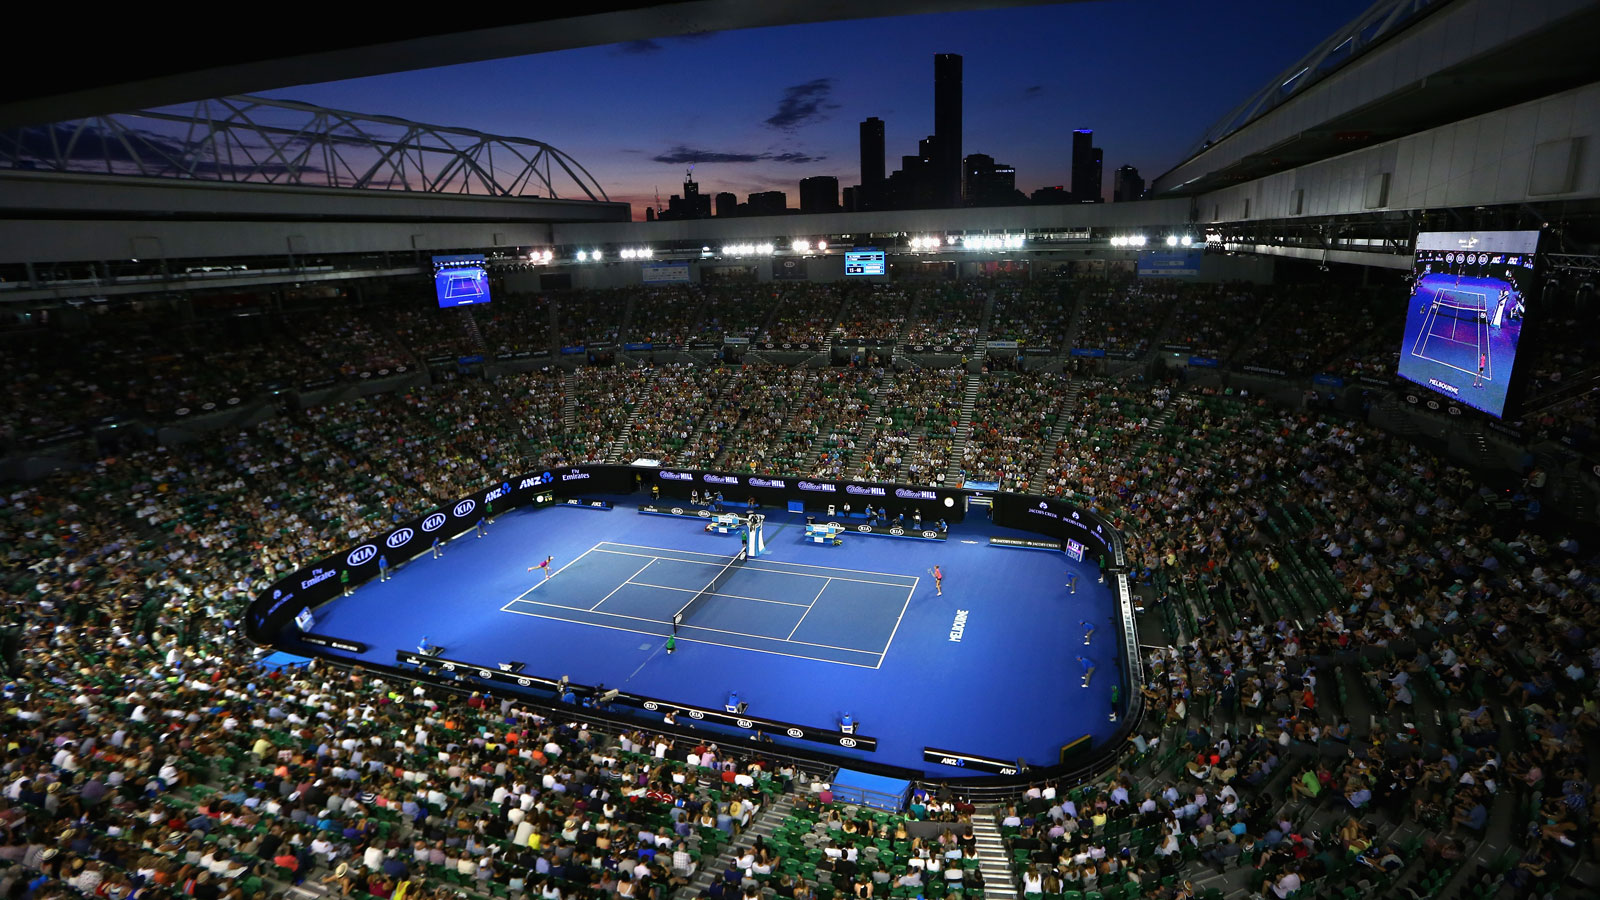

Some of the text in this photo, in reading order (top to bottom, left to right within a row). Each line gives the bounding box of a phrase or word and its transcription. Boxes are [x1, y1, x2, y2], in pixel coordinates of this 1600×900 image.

[1429, 378, 1459, 395] MELBOURNE
[562, 473, 590, 481] Emirates
[680, 473, 693, 481] HILL
[725, 476, 739, 484] HILL
[519, 476, 542, 490] ANZ
[771, 479, 786, 488] HILL
[822, 483, 837, 492] HILL
[484, 487, 502, 504] ANZ
[870, 487, 886, 496] HILL
[920, 491, 937, 500] HILL
[1044, 511, 1058, 519] CREEK
[301, 569, 336, 590] Emirates
[949, 609, 969, 642] MELBOURNE
[941, 757, 957, 766] ANZ
[1000, 767, 1017, 776] ANZ
